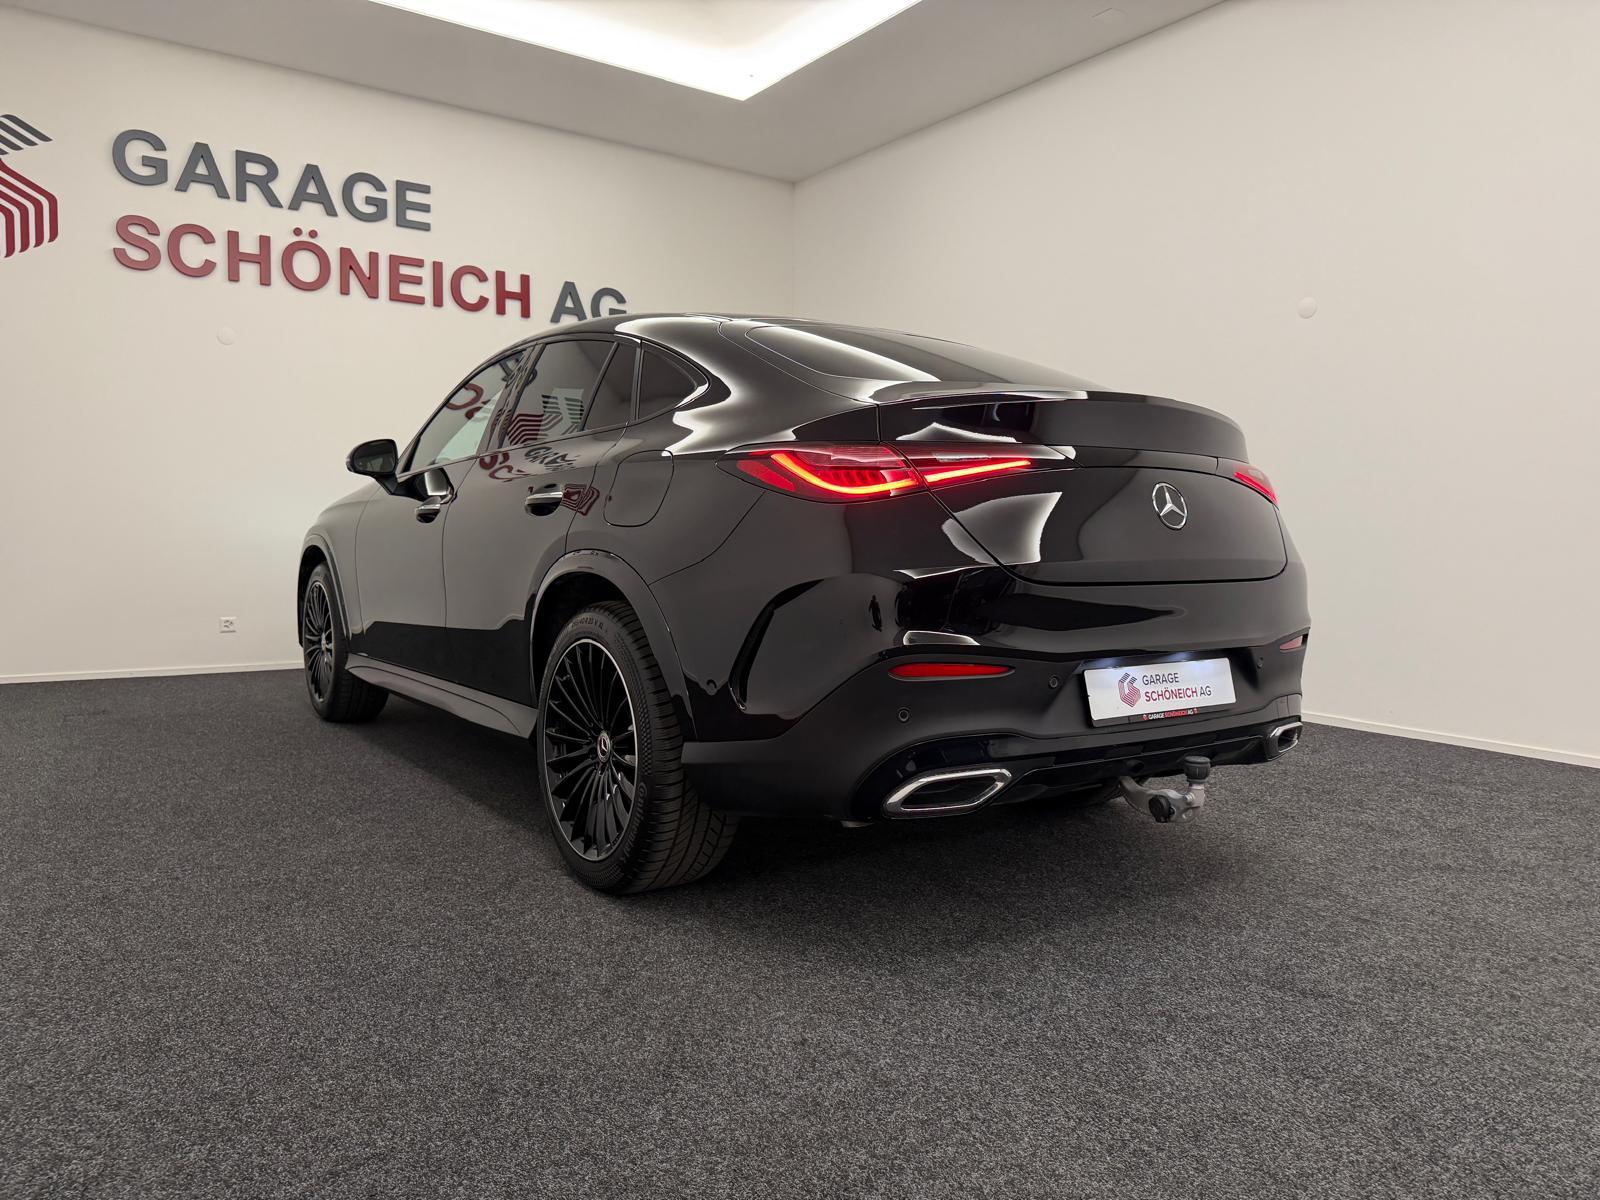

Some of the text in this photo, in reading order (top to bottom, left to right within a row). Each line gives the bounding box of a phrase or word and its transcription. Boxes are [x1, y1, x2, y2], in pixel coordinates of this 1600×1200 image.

[112, 129, 431, 231] GARAGE
[113, 214, 627, 323] SCHÖNEICH AG
[1142, 673, 1179, 686] GARAGE
[1144, 686, 1212, 702] SCHÖNEICH AG
